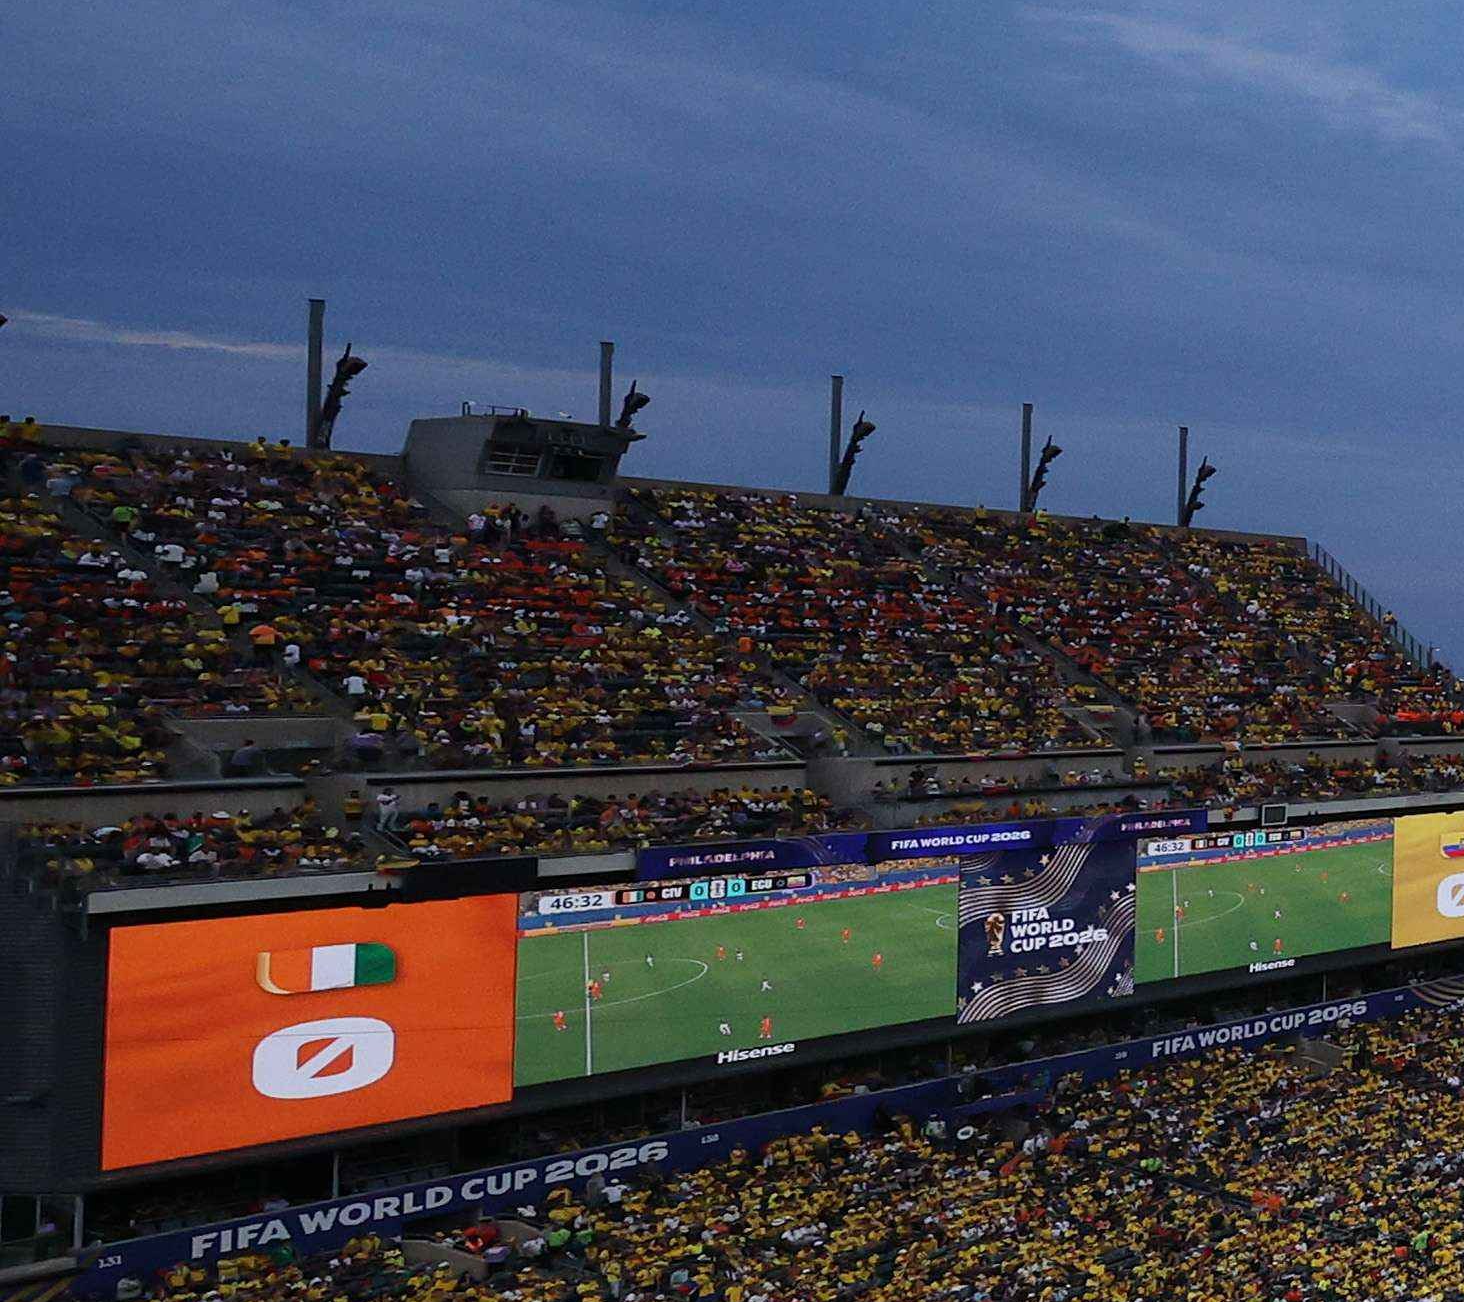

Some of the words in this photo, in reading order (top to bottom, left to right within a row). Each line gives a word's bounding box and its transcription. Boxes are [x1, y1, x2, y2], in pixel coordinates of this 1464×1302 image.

[891, 838, 919, 850] FIFA
[920, 835, 962, 848] WORLD
[963, 833, 989, 846] CUP
[990, 829, 1031, 843] 2026
[1154, 840, 1184, 854] 46:32
[668, 849, 775, 868] PHILADELPHIA
[661, 886, 682, 899] CIV
[751, 879, 773, 892] ECU
[550, 894, 603, 911] 46:32
[1011, 907, 1050, 924] FIFA
[1011, 918, 1075, 937] WORLD
[1011, 936, 1047, 954] CUP
[1048, 929, 1109, 949] 2026
[1249, 957, 1295, 974] Hisense
[1152, 1034, 1196, 1058] FIFA
[1198, 1021, 1268, 1047] WORLD
[1269, 1012, 1306, 1033] CUP
[1307, 1000, 1368, 1026] 2026
[717, 1041, 795, 1064] Hisense
[191, 1218, 290, 1260] FIFA
[300, 1183, 453, 1236] WORLD
[461, 1168, 538, 1200] CUP
[544, 1141, 669, 1186] 2026
